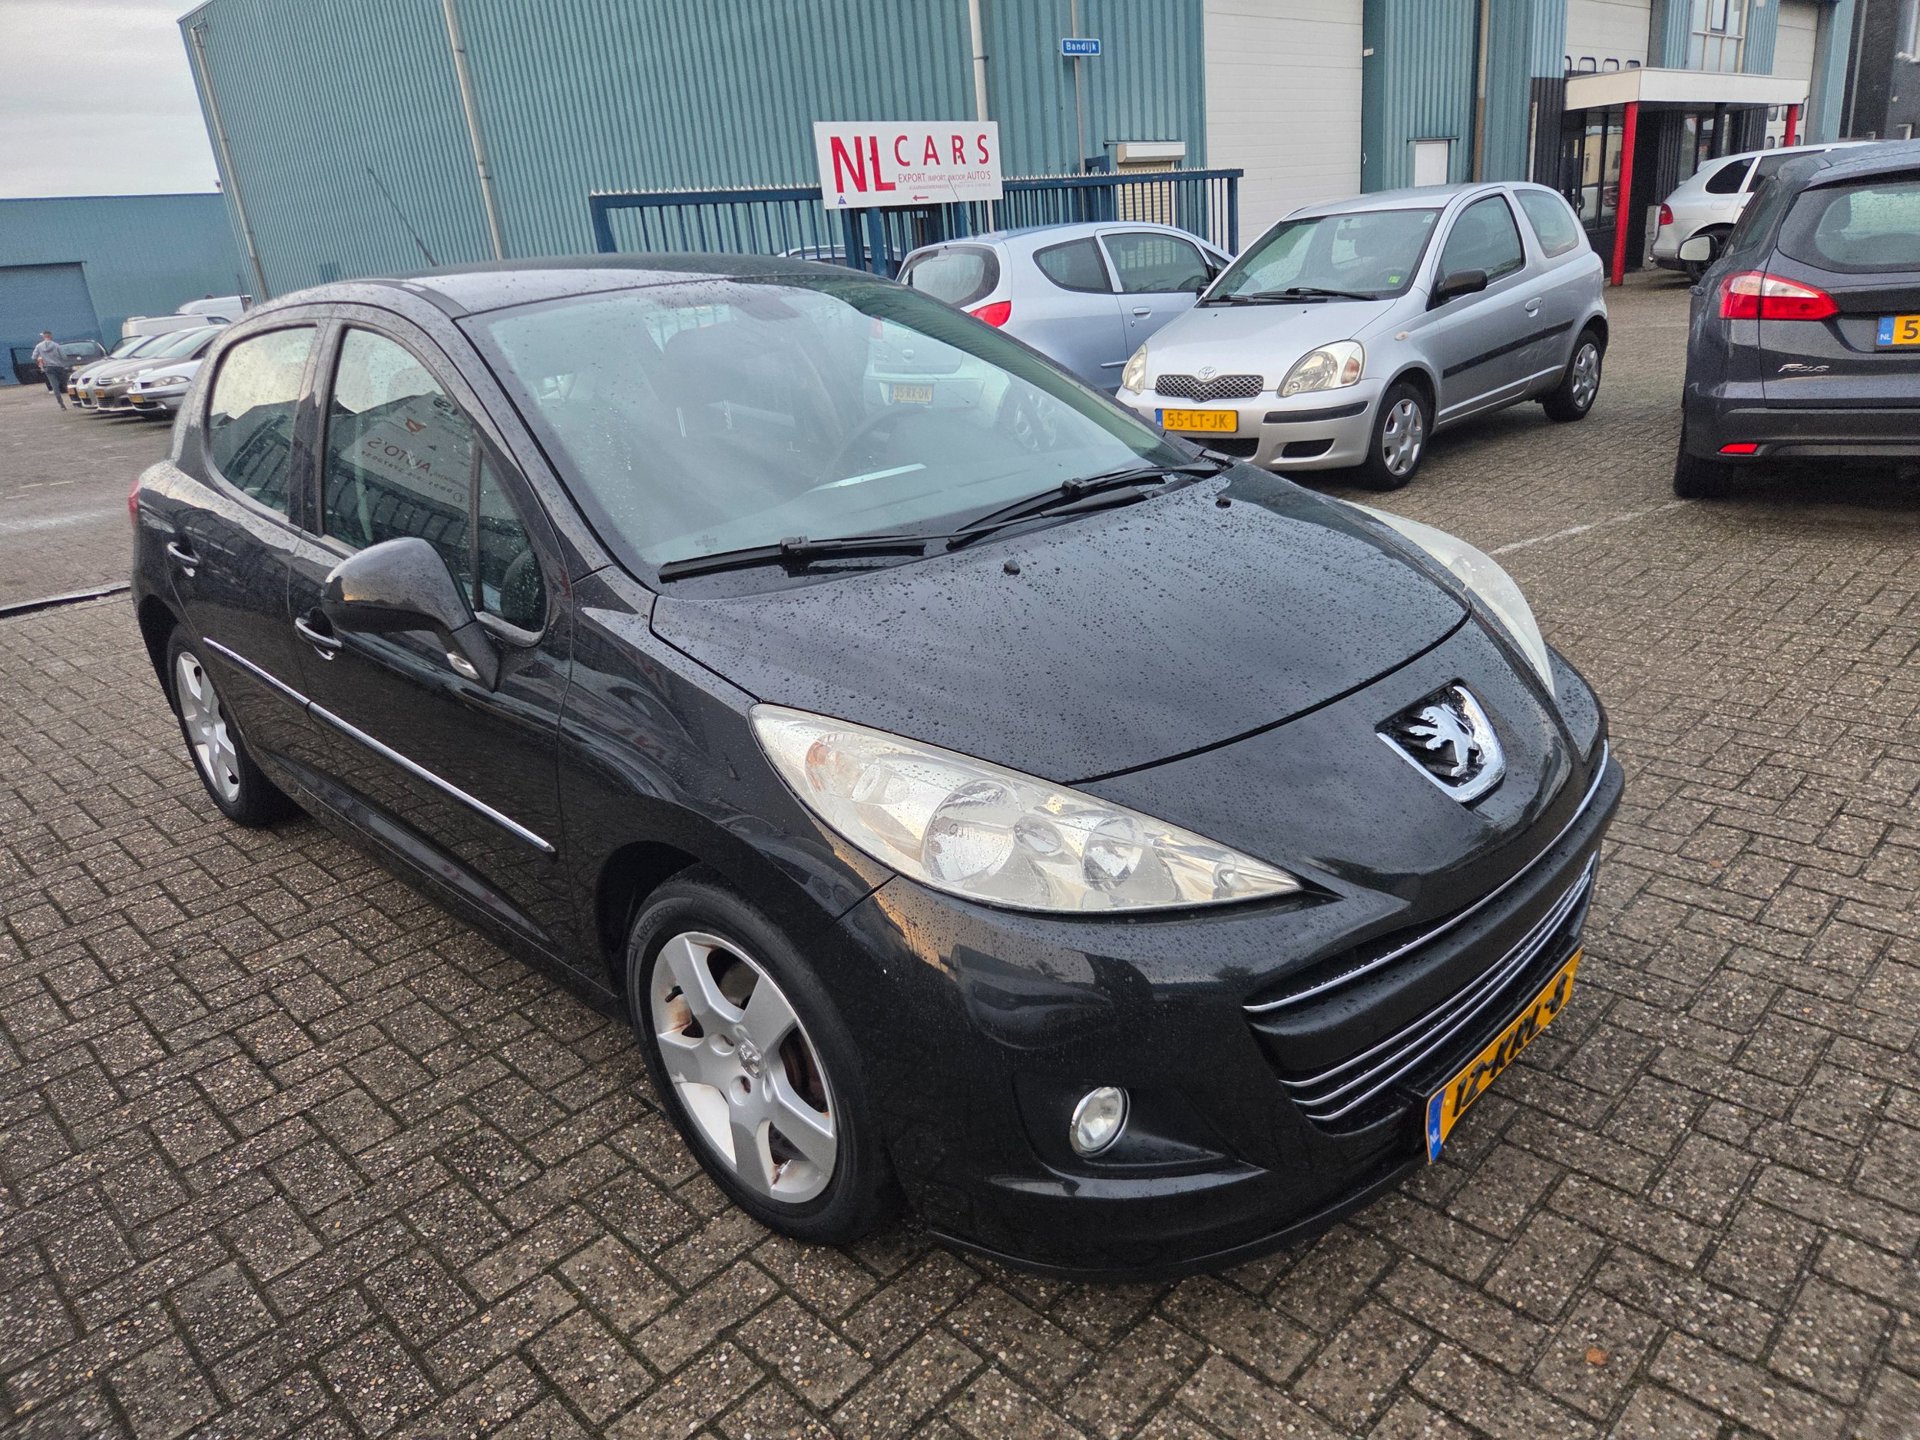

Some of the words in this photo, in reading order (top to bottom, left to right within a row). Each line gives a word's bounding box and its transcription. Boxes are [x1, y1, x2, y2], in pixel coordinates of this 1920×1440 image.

[1065, 42, 1097, 53] Bandijk
[830, 136, 896, 194] NL
[894, 134, 989, 166] CARS
[898, 173, 926, 183] EXPORT
[966, 170, 991, 180] AUTO'S
[1880, 333, 1892, 341] NL
[1778, 363, 1830, 372] Focus
[1167, 412, 1228, 429] 55-LT-JK
